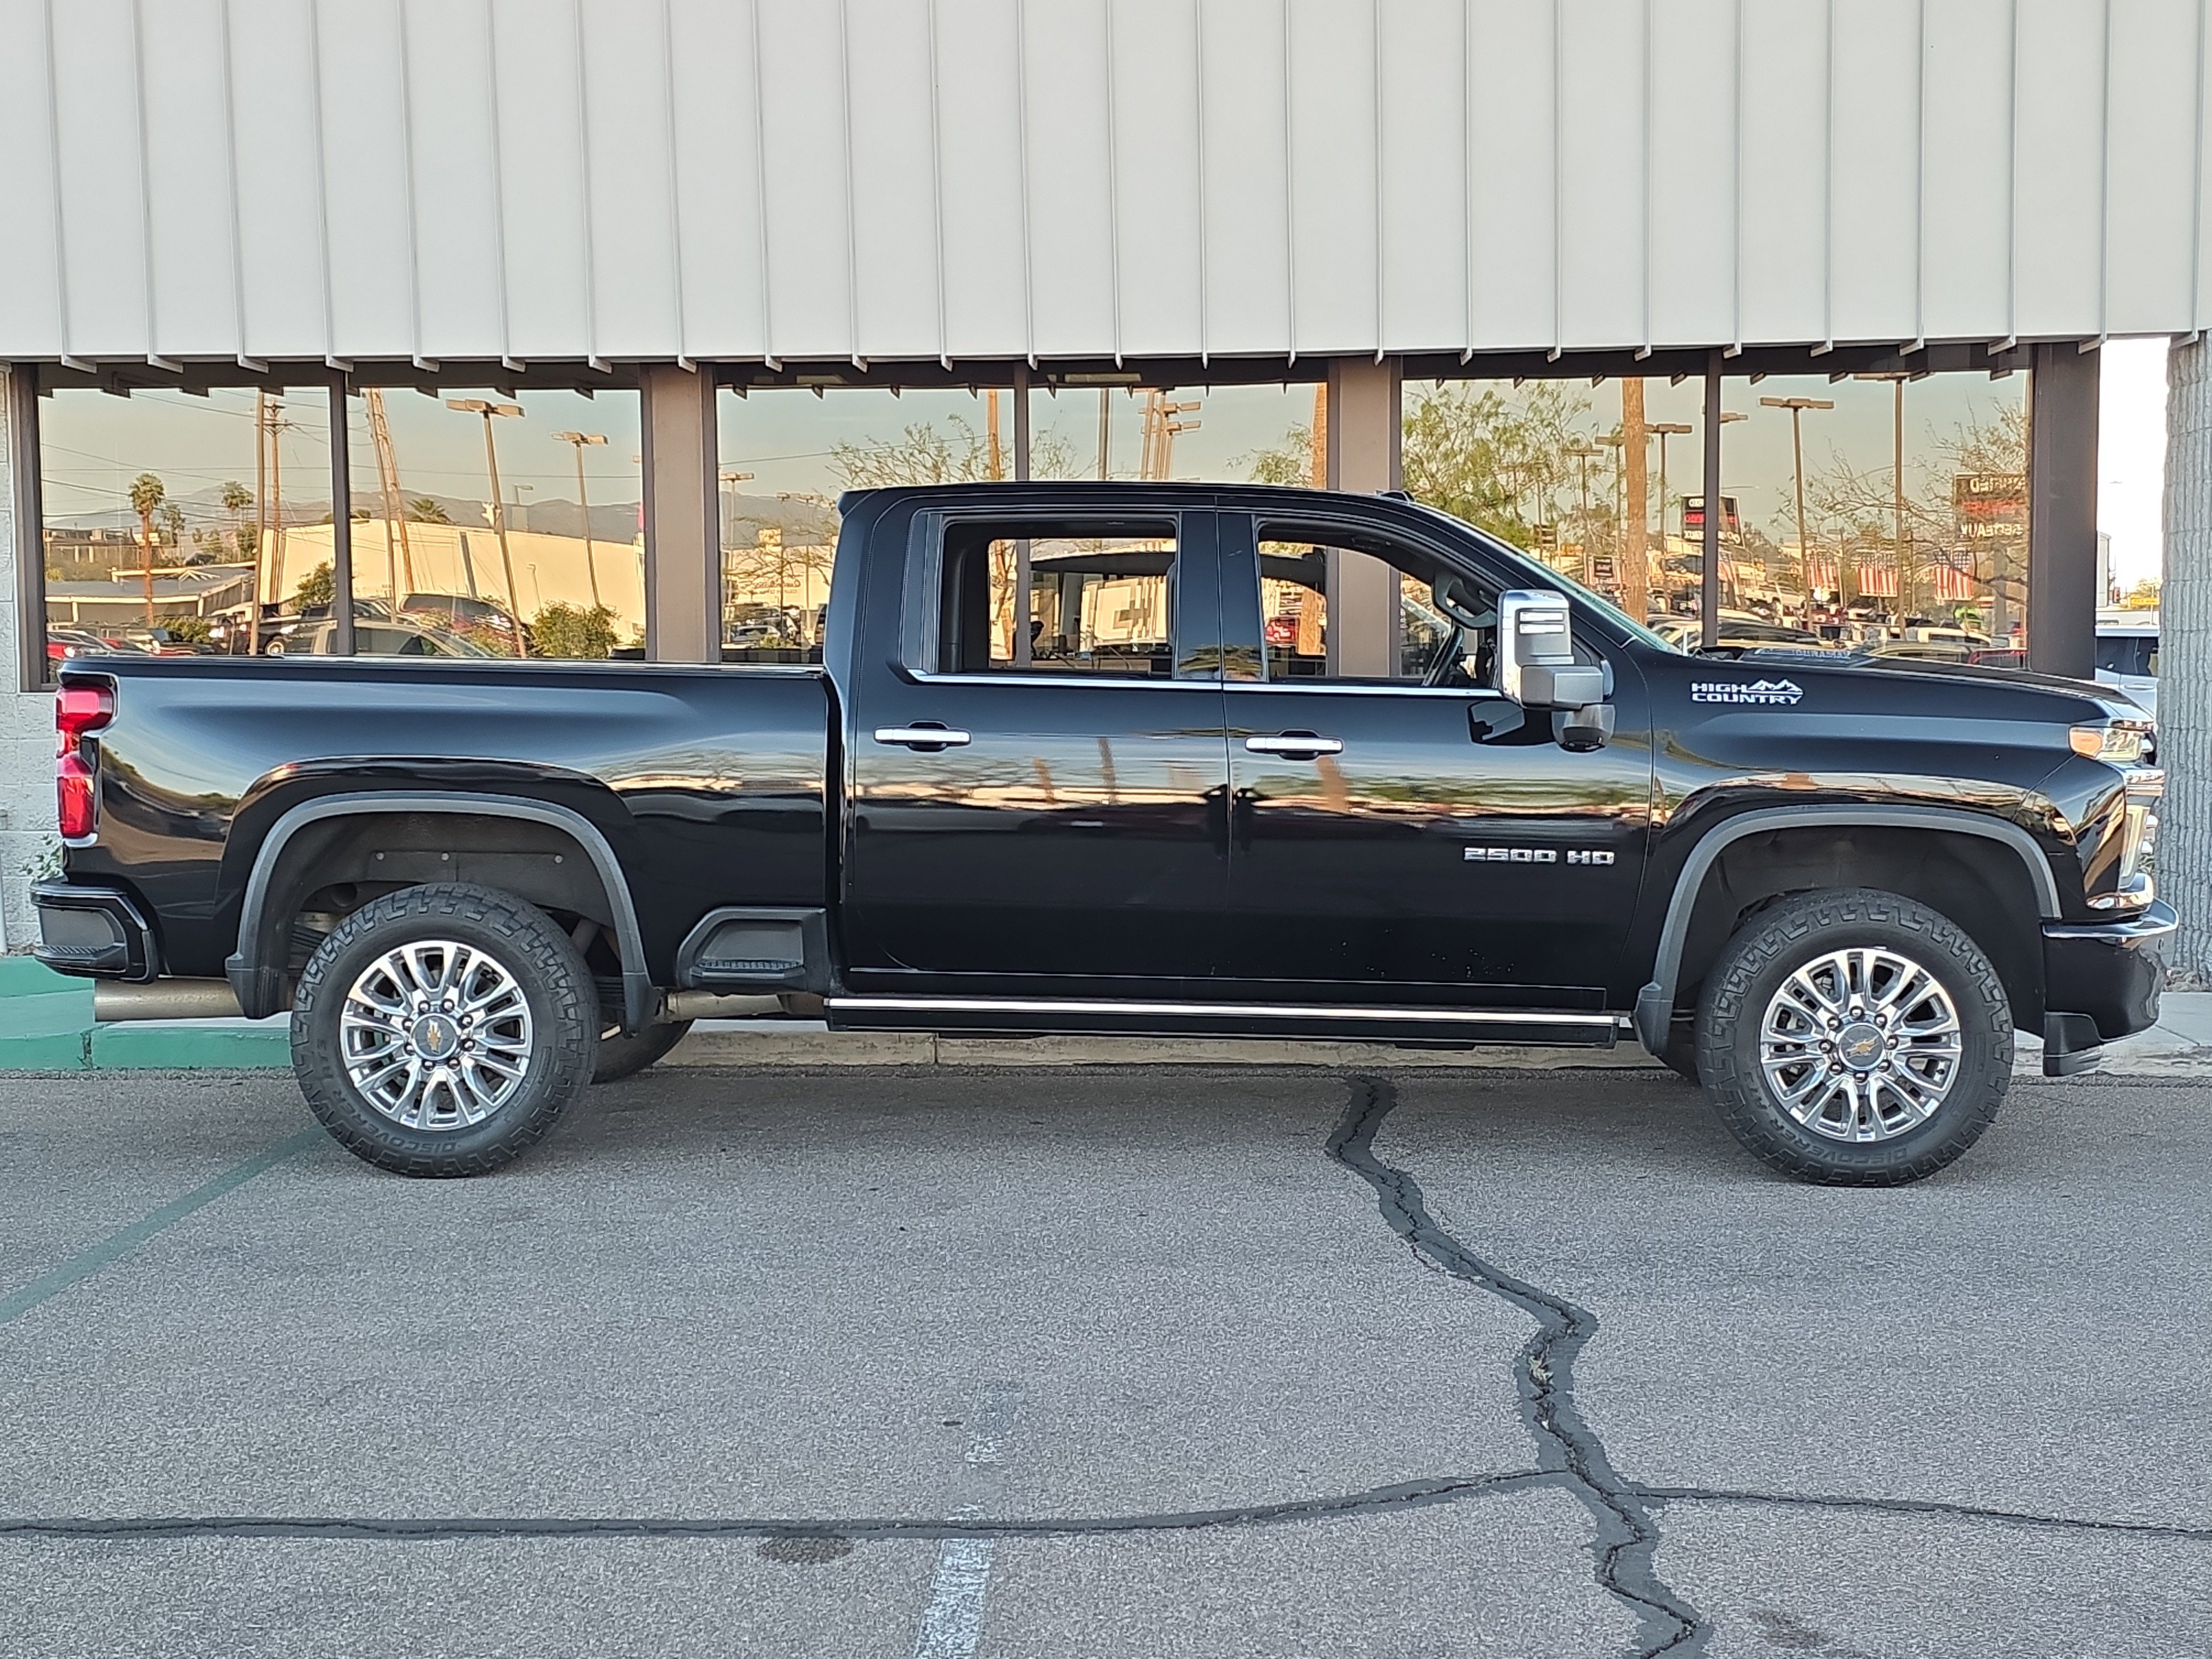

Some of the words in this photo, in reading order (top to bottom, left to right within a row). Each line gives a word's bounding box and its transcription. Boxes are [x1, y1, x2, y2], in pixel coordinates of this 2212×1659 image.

[1692, 683, 1748, 692] HIGH
[1692, 693, 1803, 705] COUNTRY
[1464, 847, 1557, 863] 2500
[1567, 851, 1615, 865] HD
[331, 1087, 458, 1154] DISCOVERER
[1768, 1116, 1908, 1166] DISCOVERER
